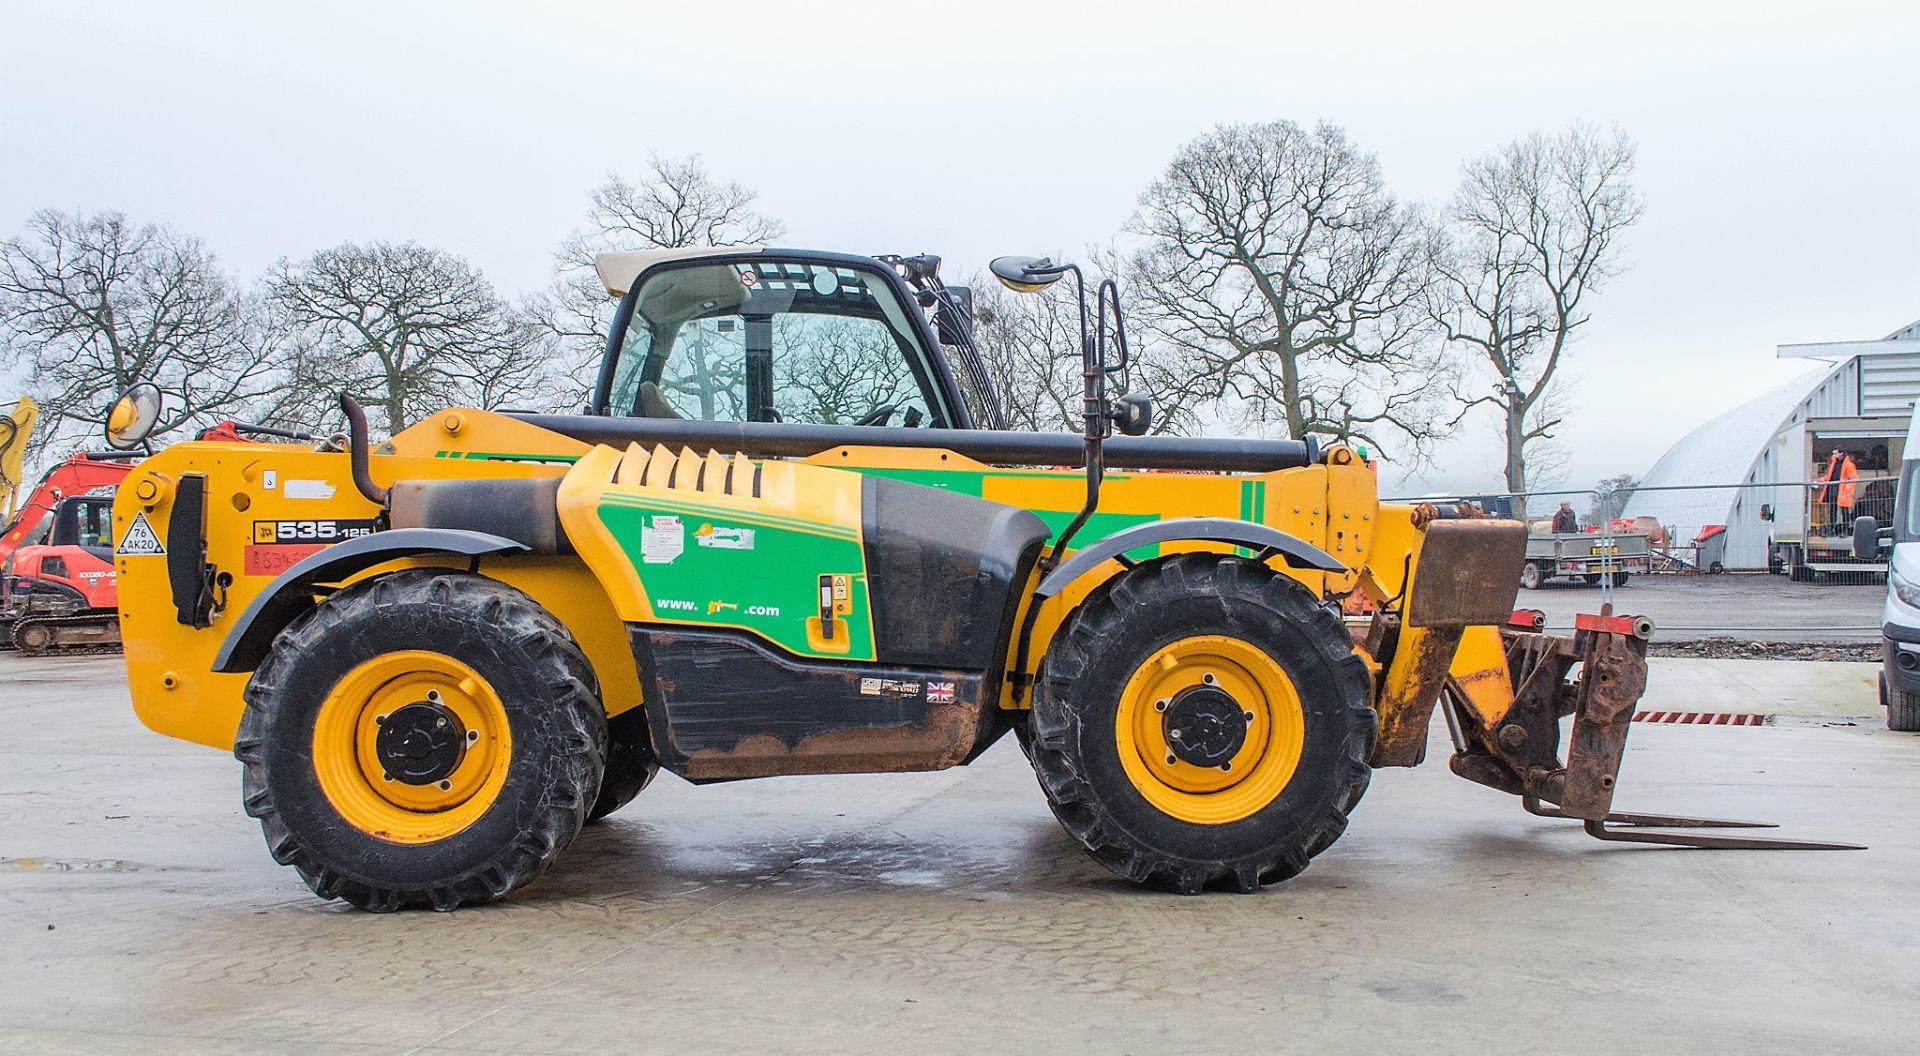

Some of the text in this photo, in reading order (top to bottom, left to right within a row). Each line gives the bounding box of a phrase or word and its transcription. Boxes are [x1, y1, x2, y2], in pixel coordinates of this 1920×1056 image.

[134, 528, 147, 538] 76
[277, 521, 370, 538] 535-125
[128, 540, 154, 550] AK20
[657, 599, 780, 616] www. .com
